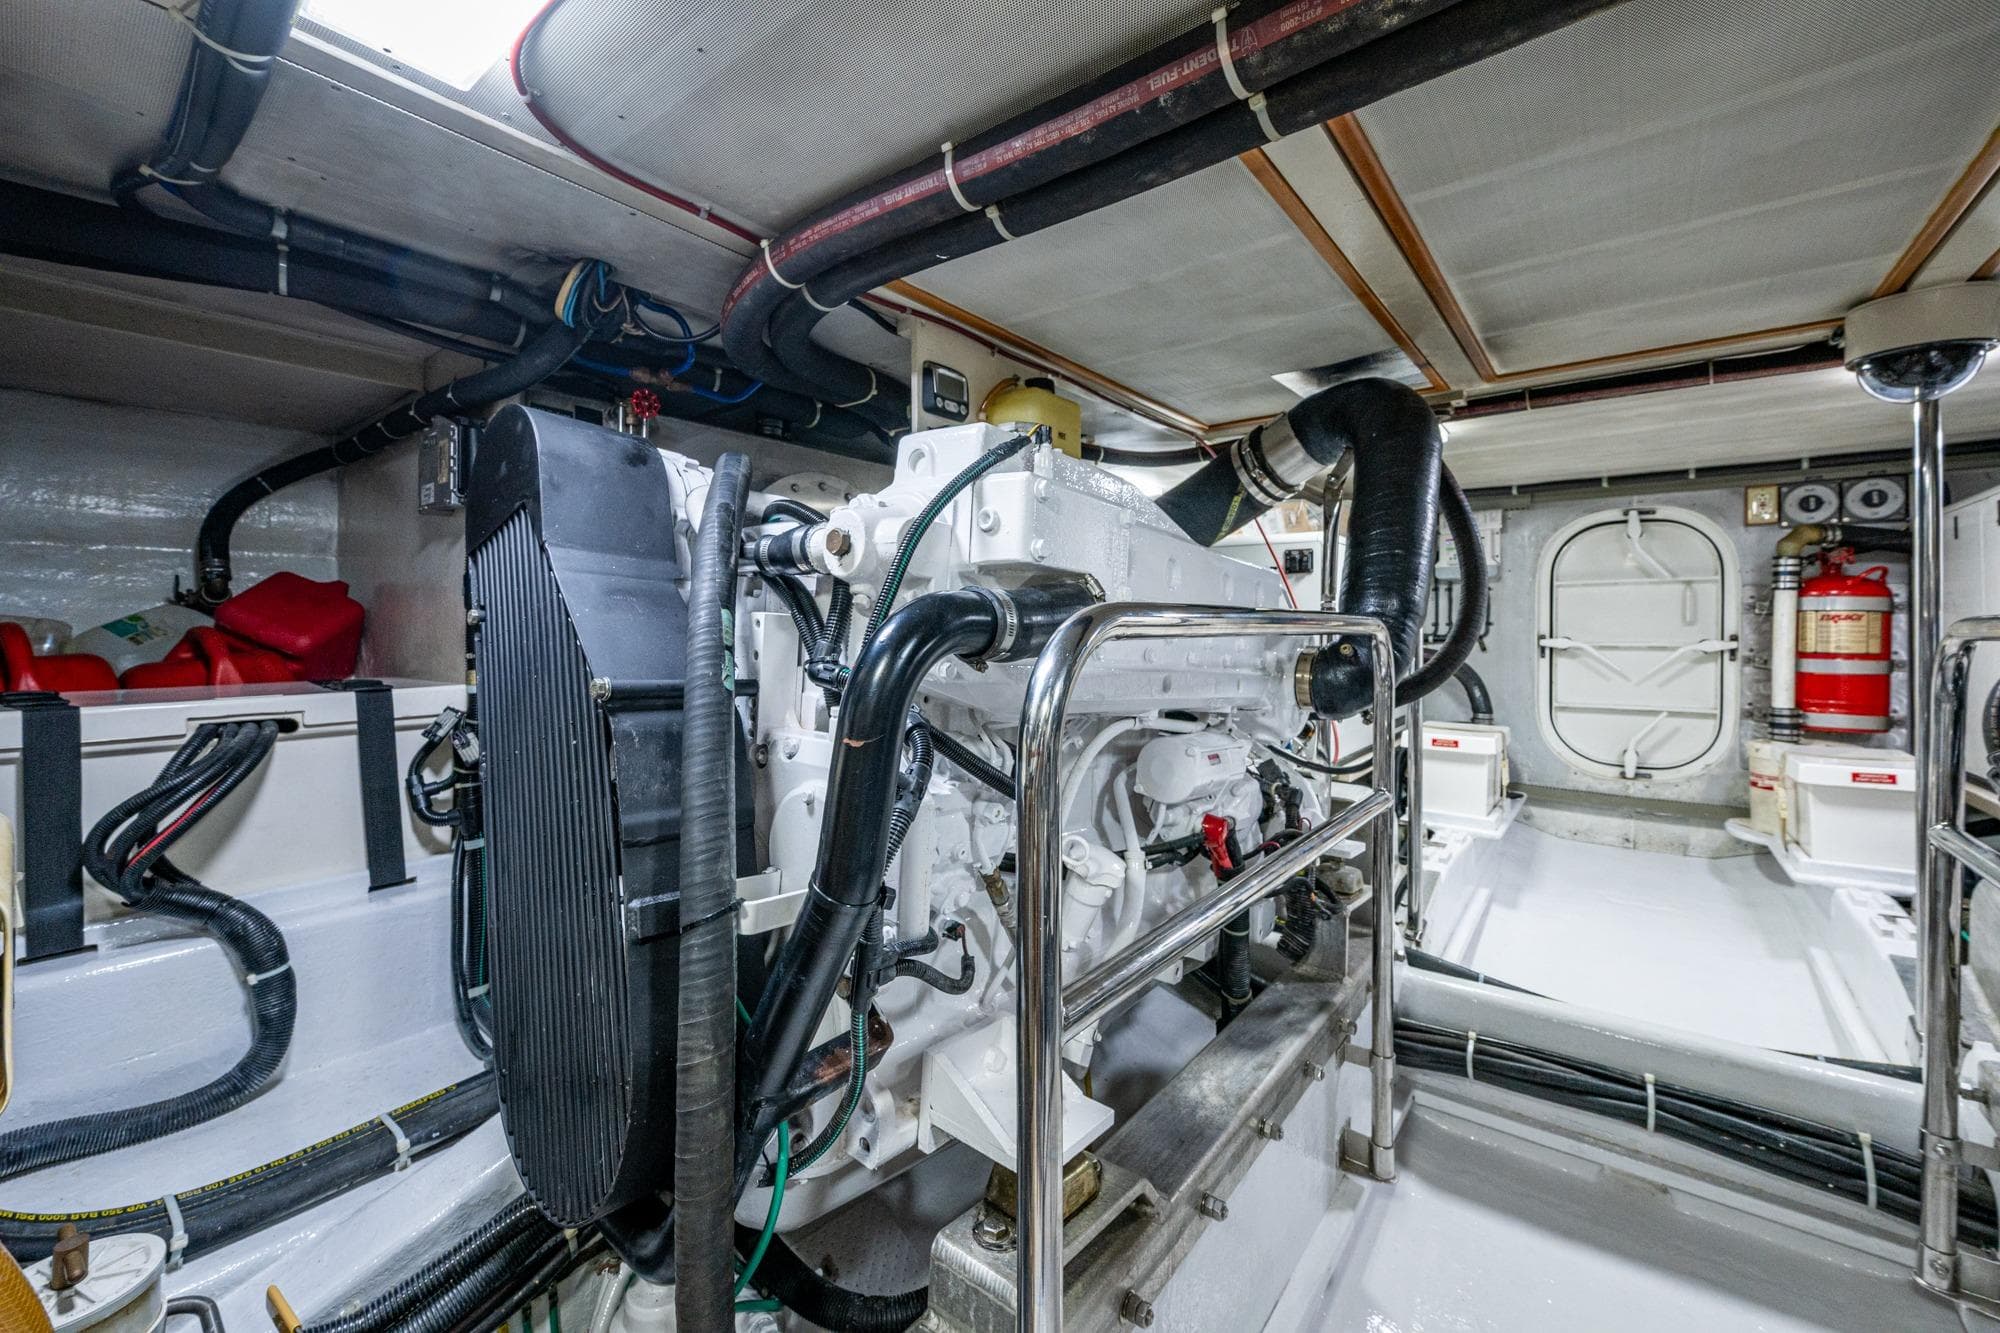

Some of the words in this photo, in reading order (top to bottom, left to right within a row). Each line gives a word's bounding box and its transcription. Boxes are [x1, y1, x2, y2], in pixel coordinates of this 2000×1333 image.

[1146, 37, 1240, 91] TDENT-FUEL
[882, 176, 940, 205] TRIDENT-FUEL
[70, 1211, 98, 1219] BAR
